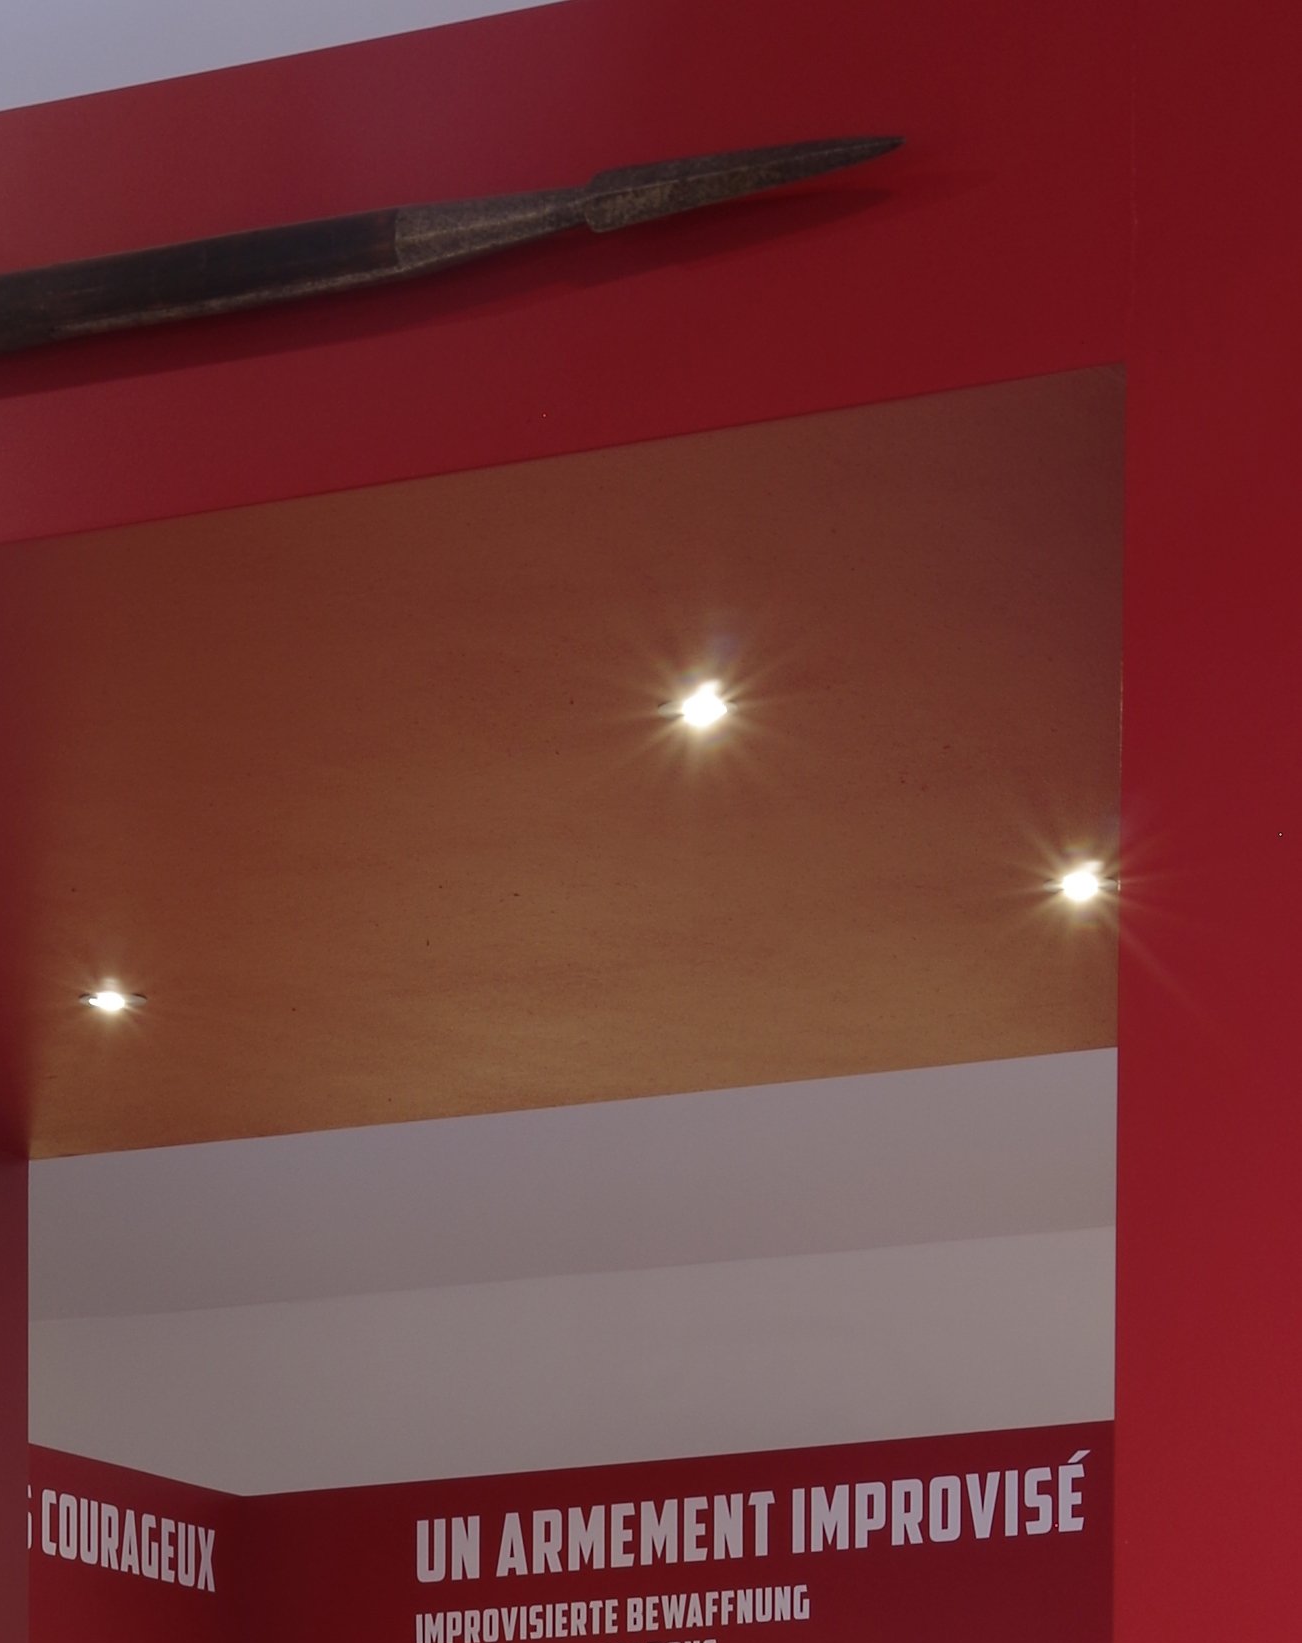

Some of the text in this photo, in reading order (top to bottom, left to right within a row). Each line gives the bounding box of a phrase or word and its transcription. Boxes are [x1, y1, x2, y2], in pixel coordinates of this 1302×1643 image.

[42, 1489, 216, 1592] COURAGEUX
[417, 1450, 1091, 1583] UN ARMEMENT IMPROVISÉ
[626, 1584, 810, 1632] BEWAFFNUNG
